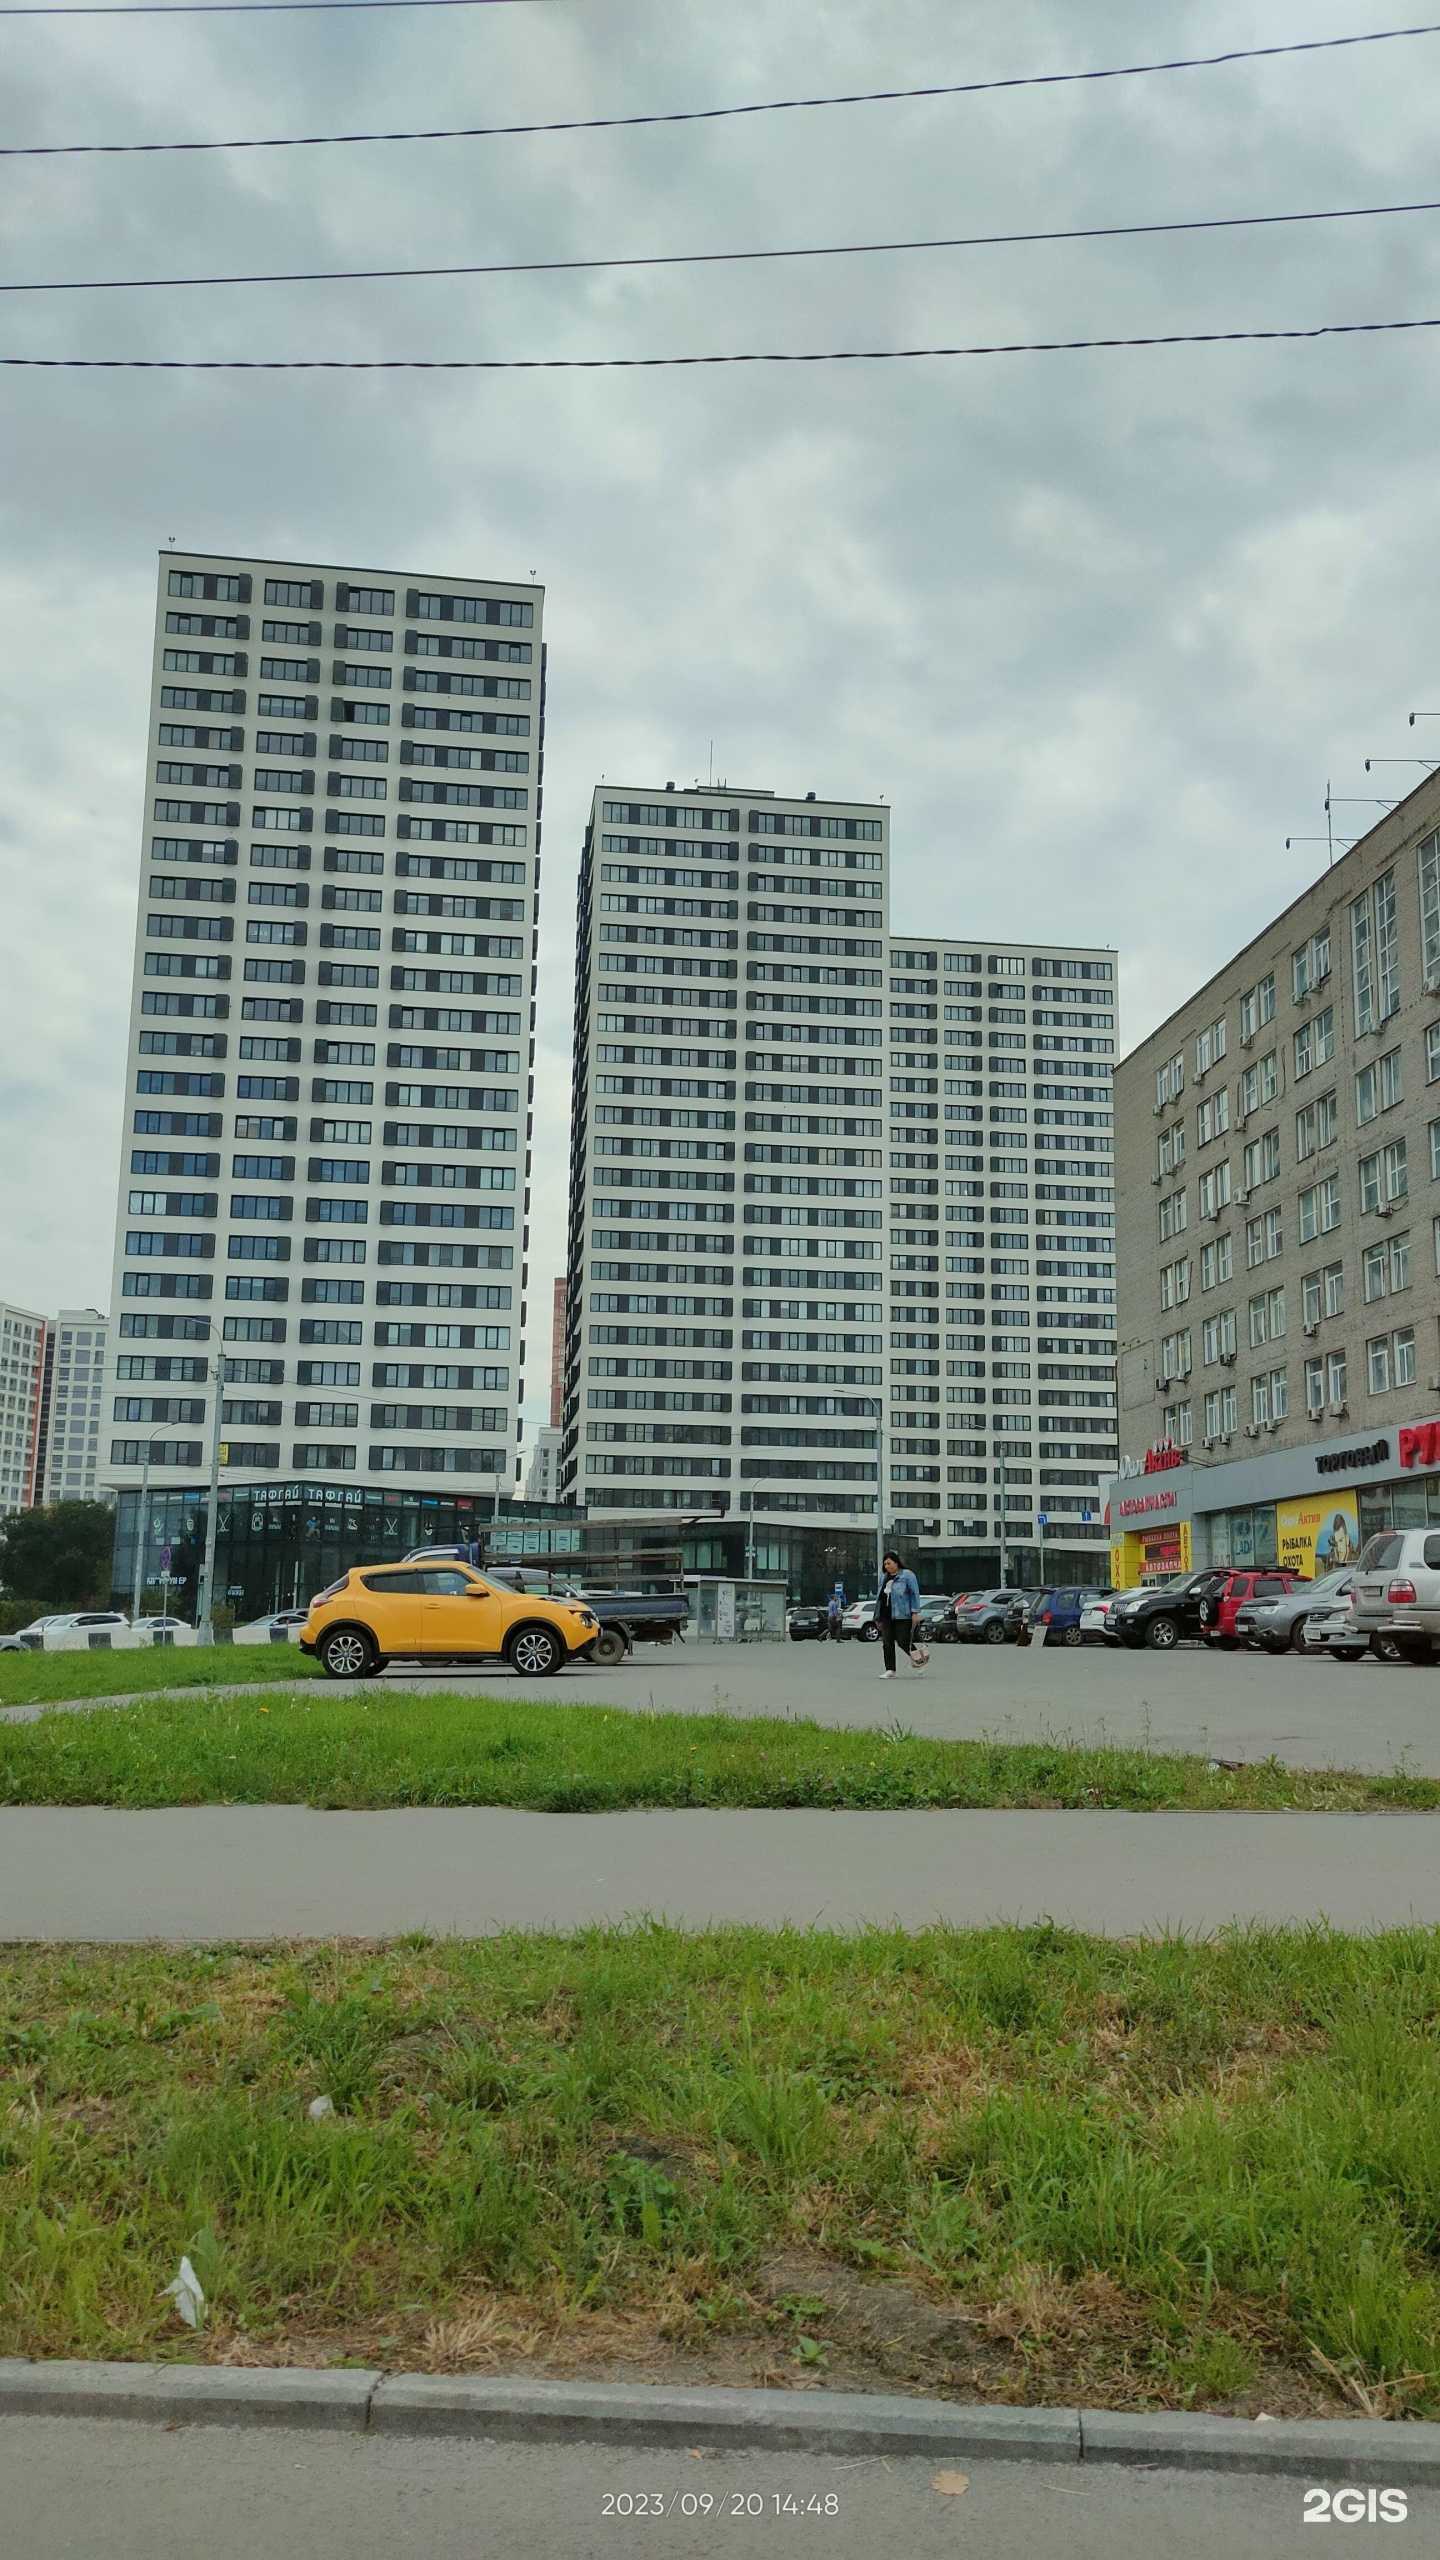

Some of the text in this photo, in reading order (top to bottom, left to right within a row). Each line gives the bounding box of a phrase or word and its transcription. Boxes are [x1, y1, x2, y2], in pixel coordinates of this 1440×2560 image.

[1399, 1421, 1440, 1468] РУ
[254, 1484, 300, 1501] ТАФГАЙ
[308, 1488, 362, 1504] ТАФГАЙ
[1282, 1535, 1312, 1551] РЫБАЛКА
[1283, 1554, 1304, 1568] ОХОТА
